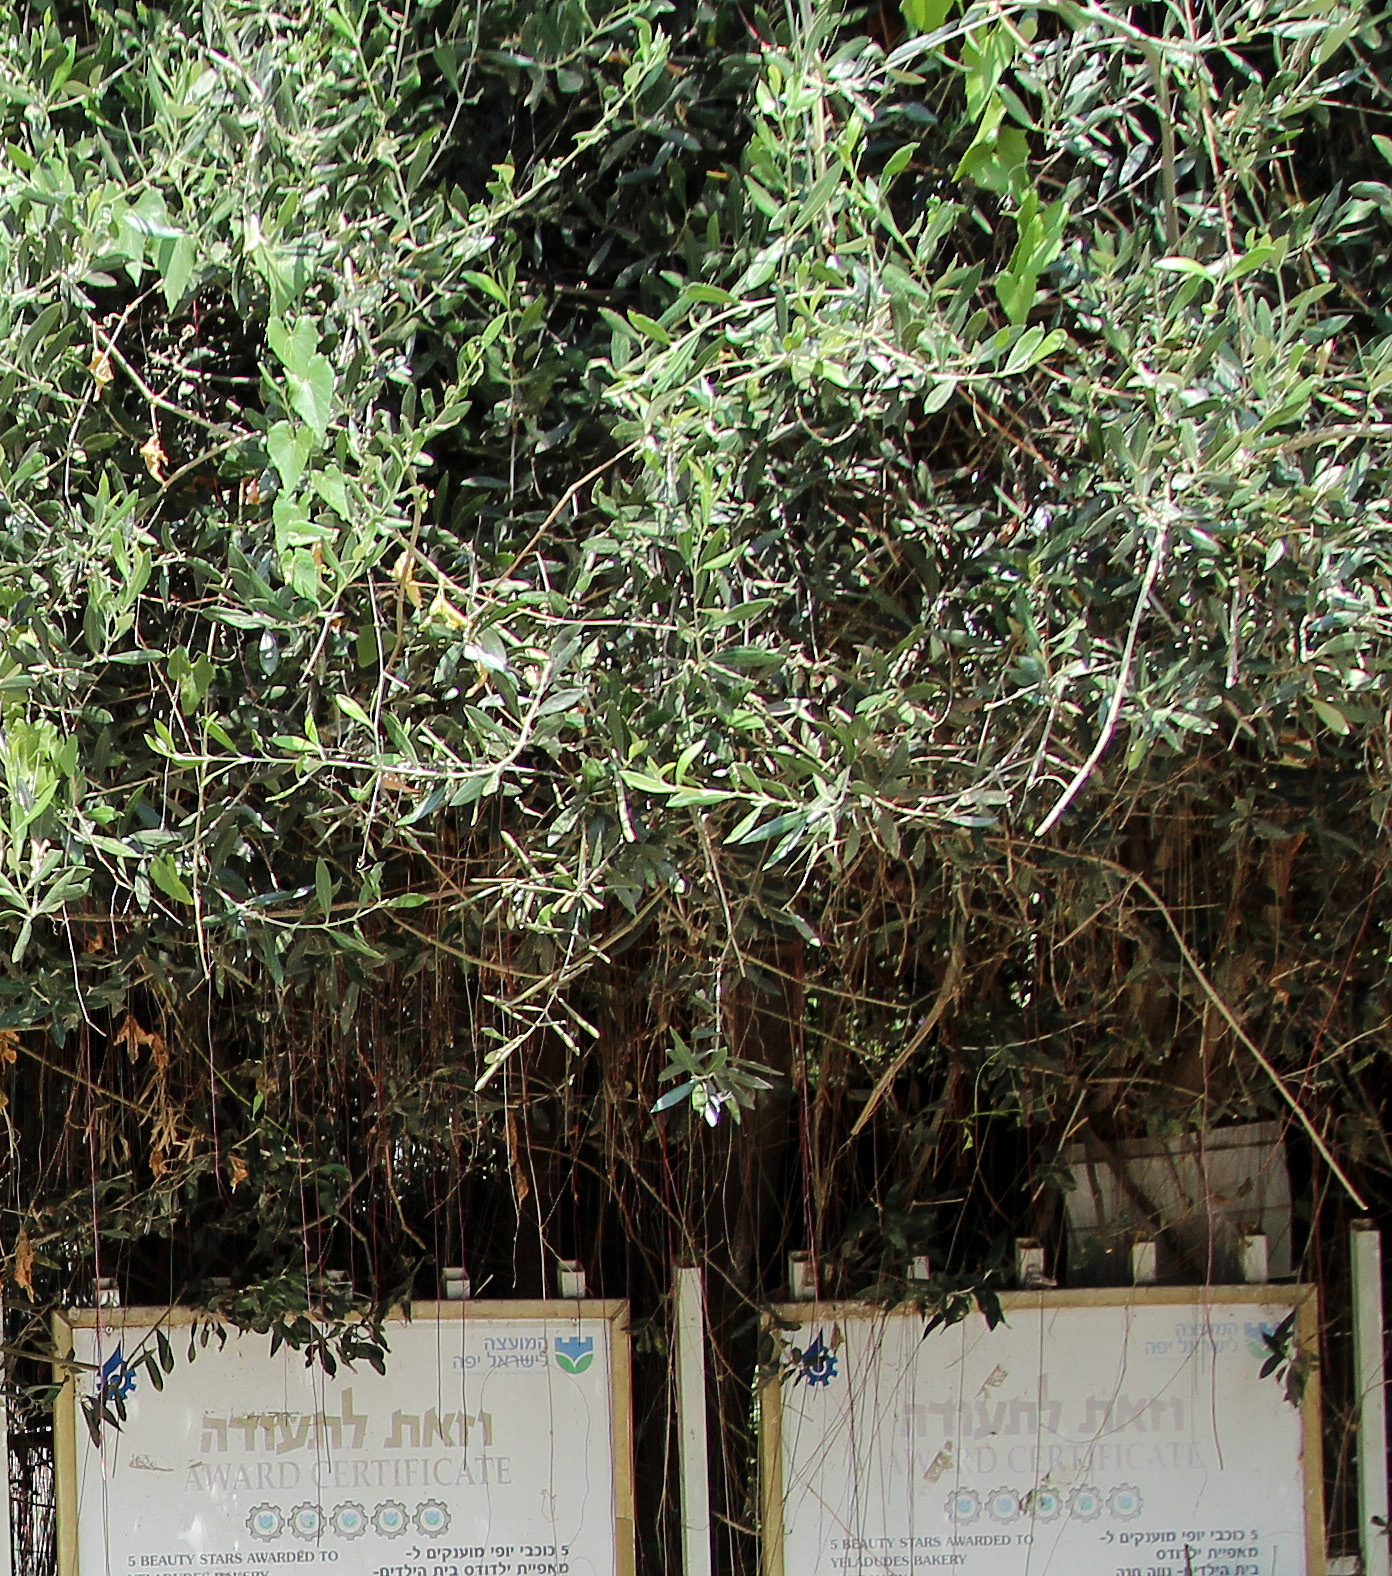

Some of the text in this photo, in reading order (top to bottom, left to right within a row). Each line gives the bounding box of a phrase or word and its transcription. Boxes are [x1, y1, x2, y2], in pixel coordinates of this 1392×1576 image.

[484, 1336, 547, 1351] המועצה
[453, 1351, 548, 1369] לישראל יפה
[200, 1387, 493, 1455] וזאת לתעודה
[184, 1456, 512, 1491] AWARD CERTIFICATE
[830, 1534, 1034, 1550] 5 BEAUTY STARS AWARDED TO
[1251, 1530, 1258, 1541] 5
[426, 1548, 485, 1563] מוענקים
[491, 1547, 514, 1558] יופי
[520, 1546, 556, 1557] כוכבי
[561, 1545, 569, 1556] 5
[128, 1550, 339, 1567] 5 BEAUTY STARS AWARDED TO
[830, 1554, 967, 1568] YELADUDES BAKERY
